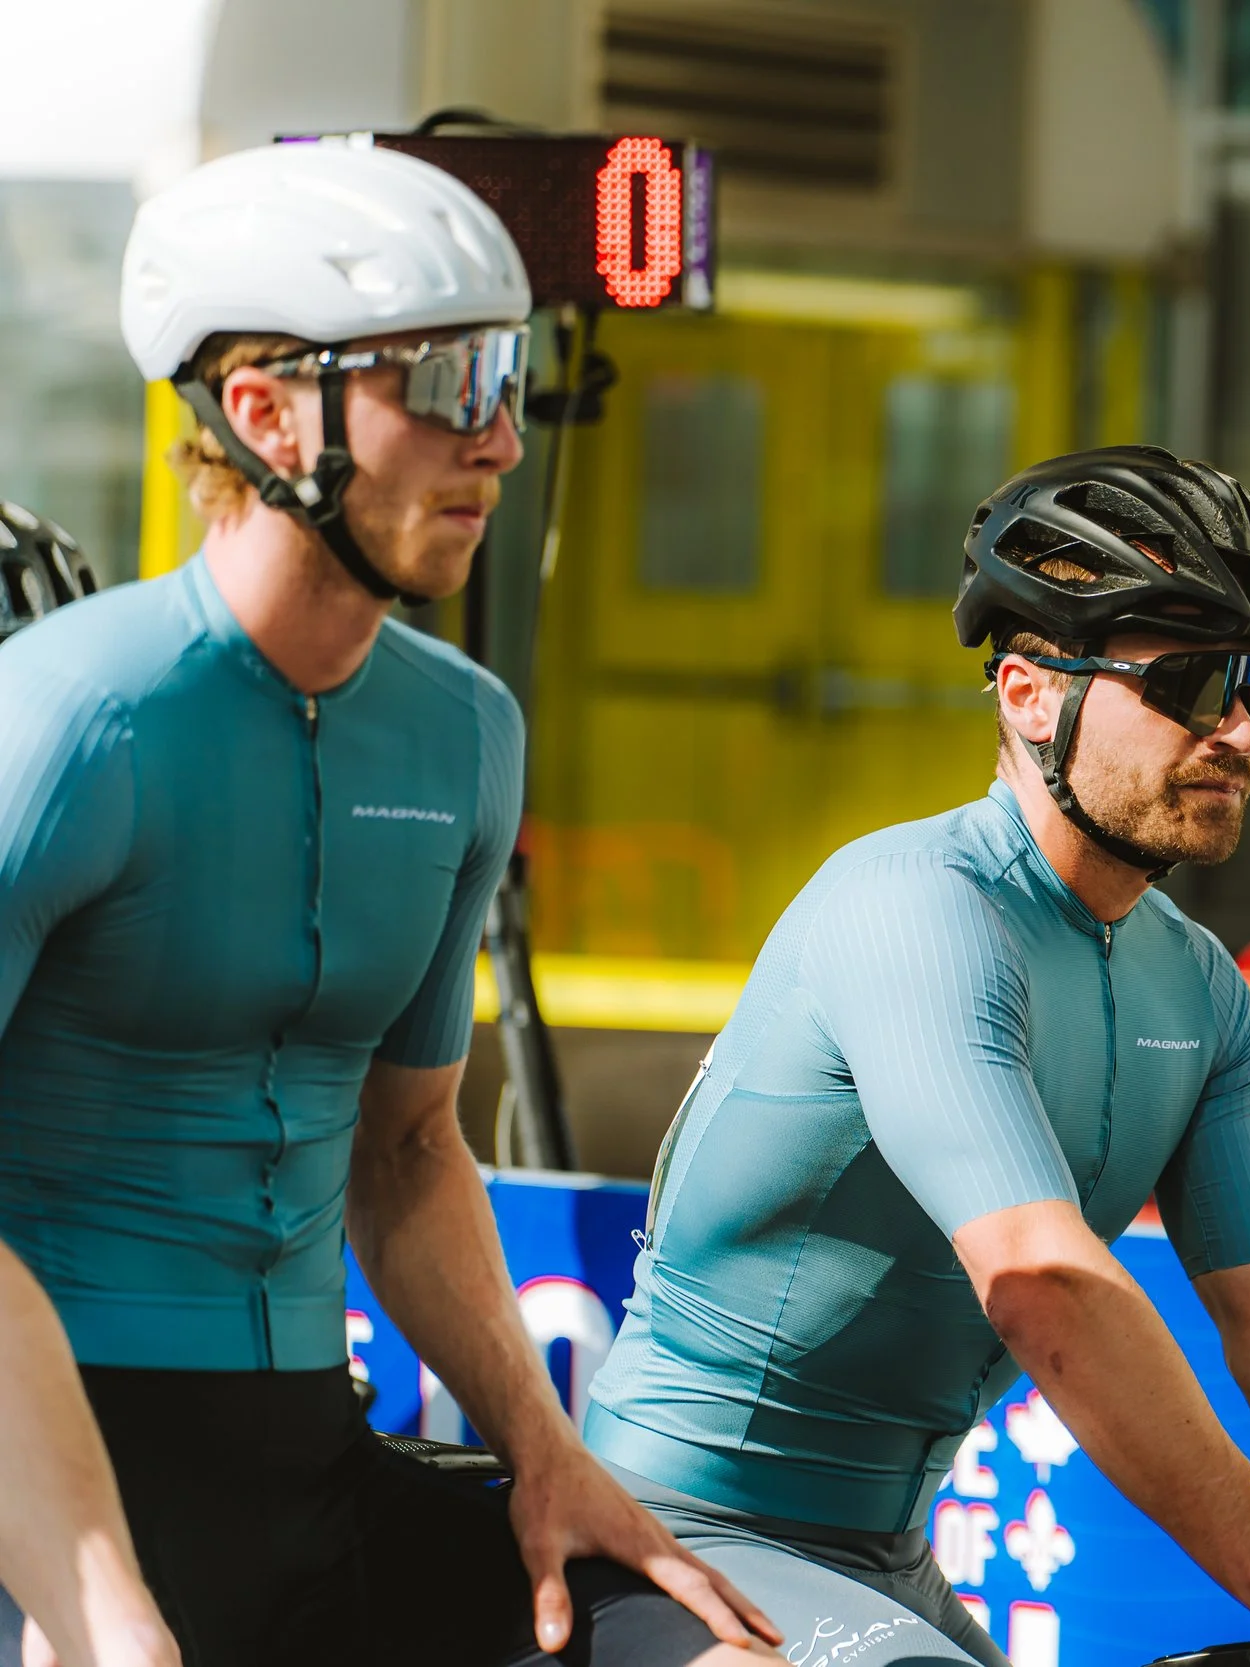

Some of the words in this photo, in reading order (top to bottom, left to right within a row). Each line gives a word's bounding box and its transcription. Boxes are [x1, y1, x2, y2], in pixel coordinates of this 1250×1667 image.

[596, 137, 682, 307] 0
[352, 804, 456, 825] MAGNAN
[1136, 1037, 1200, 1050] MAGNAN
[934, 1499, 1000, 1587] OF
[842, 1630, 896, 1664] cycliste
